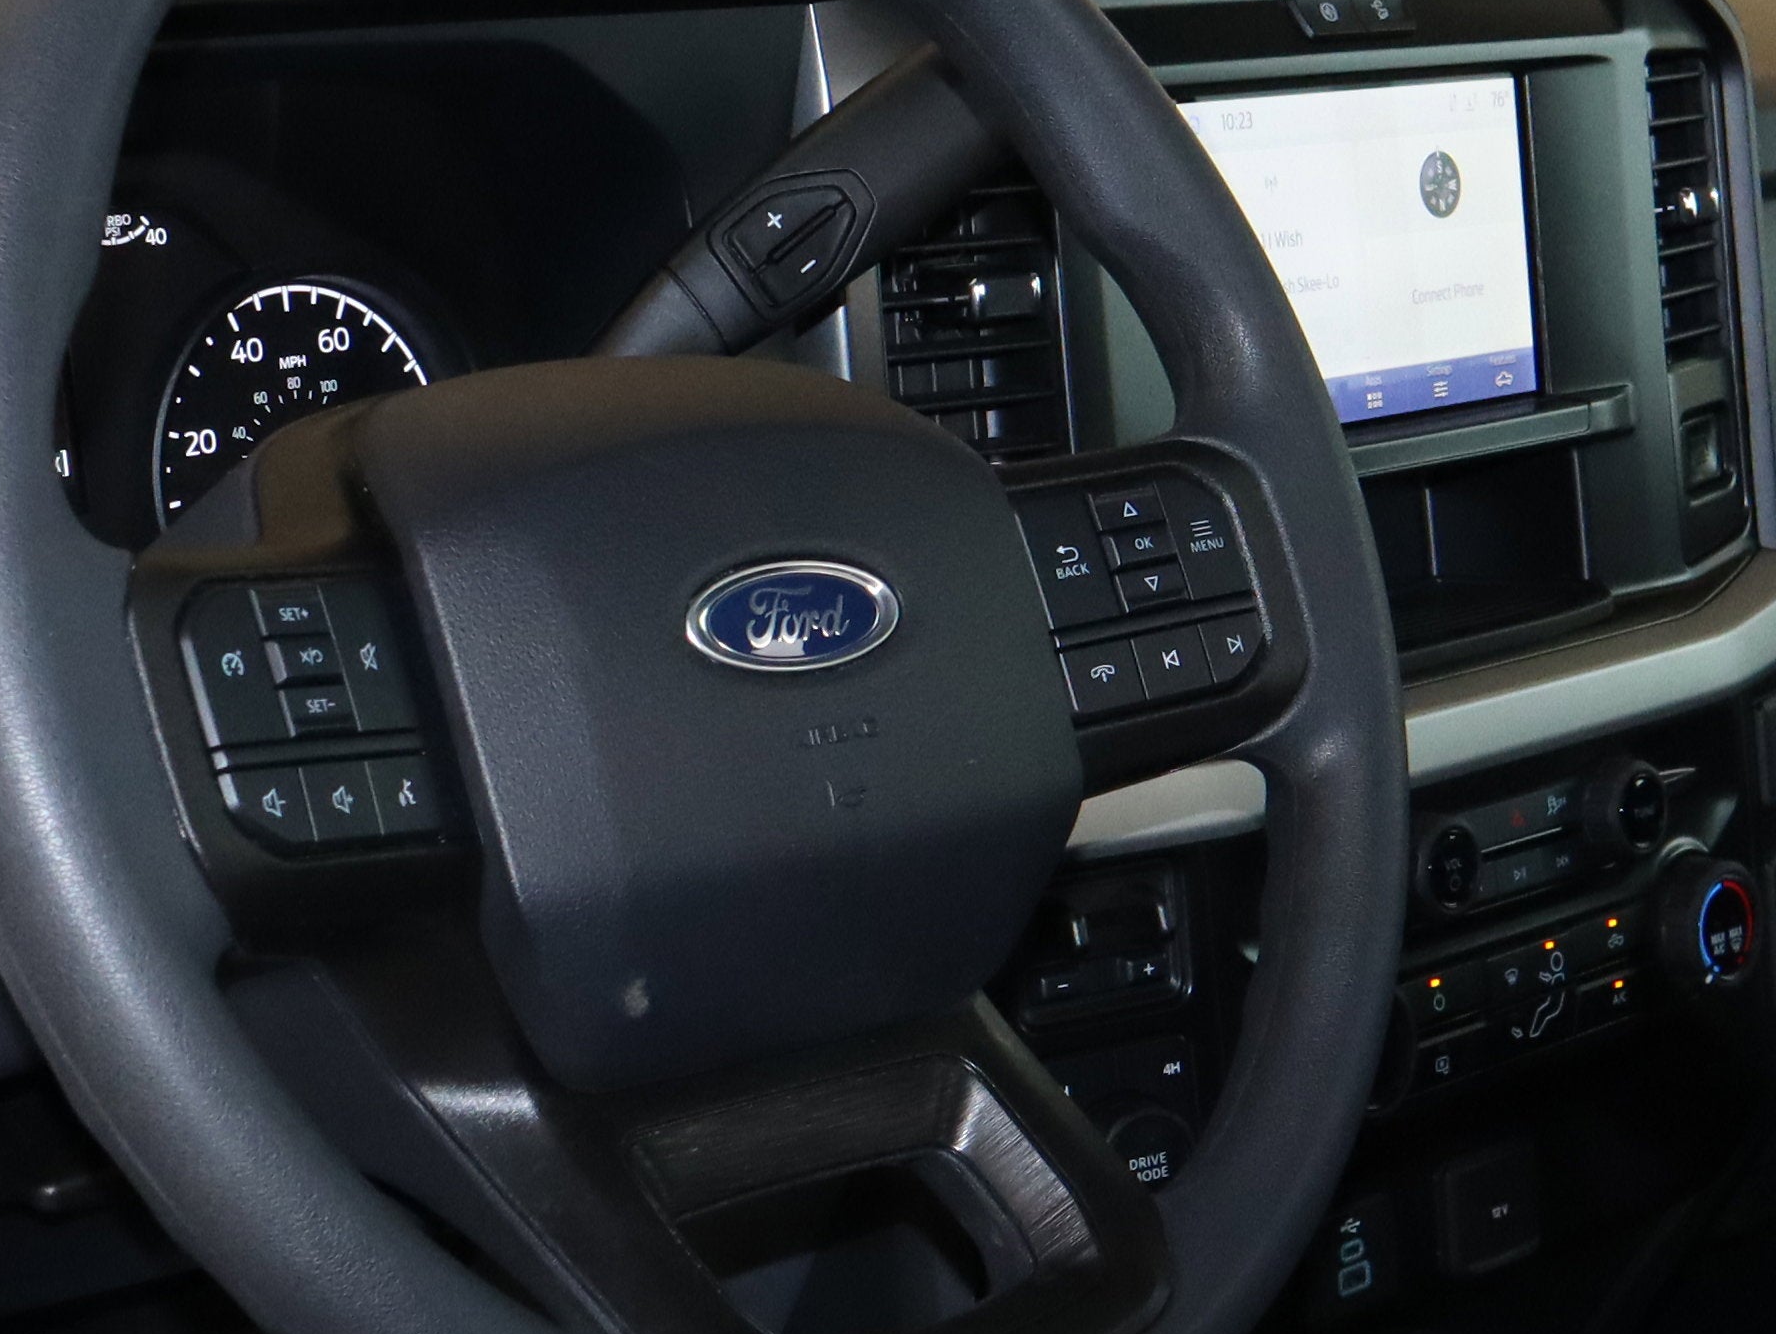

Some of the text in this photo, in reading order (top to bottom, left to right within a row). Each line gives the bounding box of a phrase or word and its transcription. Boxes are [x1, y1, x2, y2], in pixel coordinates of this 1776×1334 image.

[1221, 111, 1253, 130] 10:23
[106, 214, 132, 227] RBO
[145, 227, 167, 246] 40
[1274, 230, 1303, 249] Wish
[1297, 274, 1340, 294] Skee-Lo
[1411, 283, 1485, 305] Connect Phone
[317, 326, 350, 354] 60
[230, 337, 263, 364] 40
[279, 354, 307, 370] MPH
[287, 375, 301, 390] 80
[319, 379, 338, 393] 100
[253, 391, 268, 405] 60
[232, 426, 246, 440] 40
[183, 428, 217, 458] 20
[1134, 536, 1154, 551] OK
[1190, 536, 1224, 554] MENU
[1055, 563, 1091, 581] BACK
[278, 606, 310, 622] SET+
[746, 584, 851, 650] Ford
[1162, 1061, 1182, 1076] 4H
[1128, 1151, 1168, 1172] DRIVE
